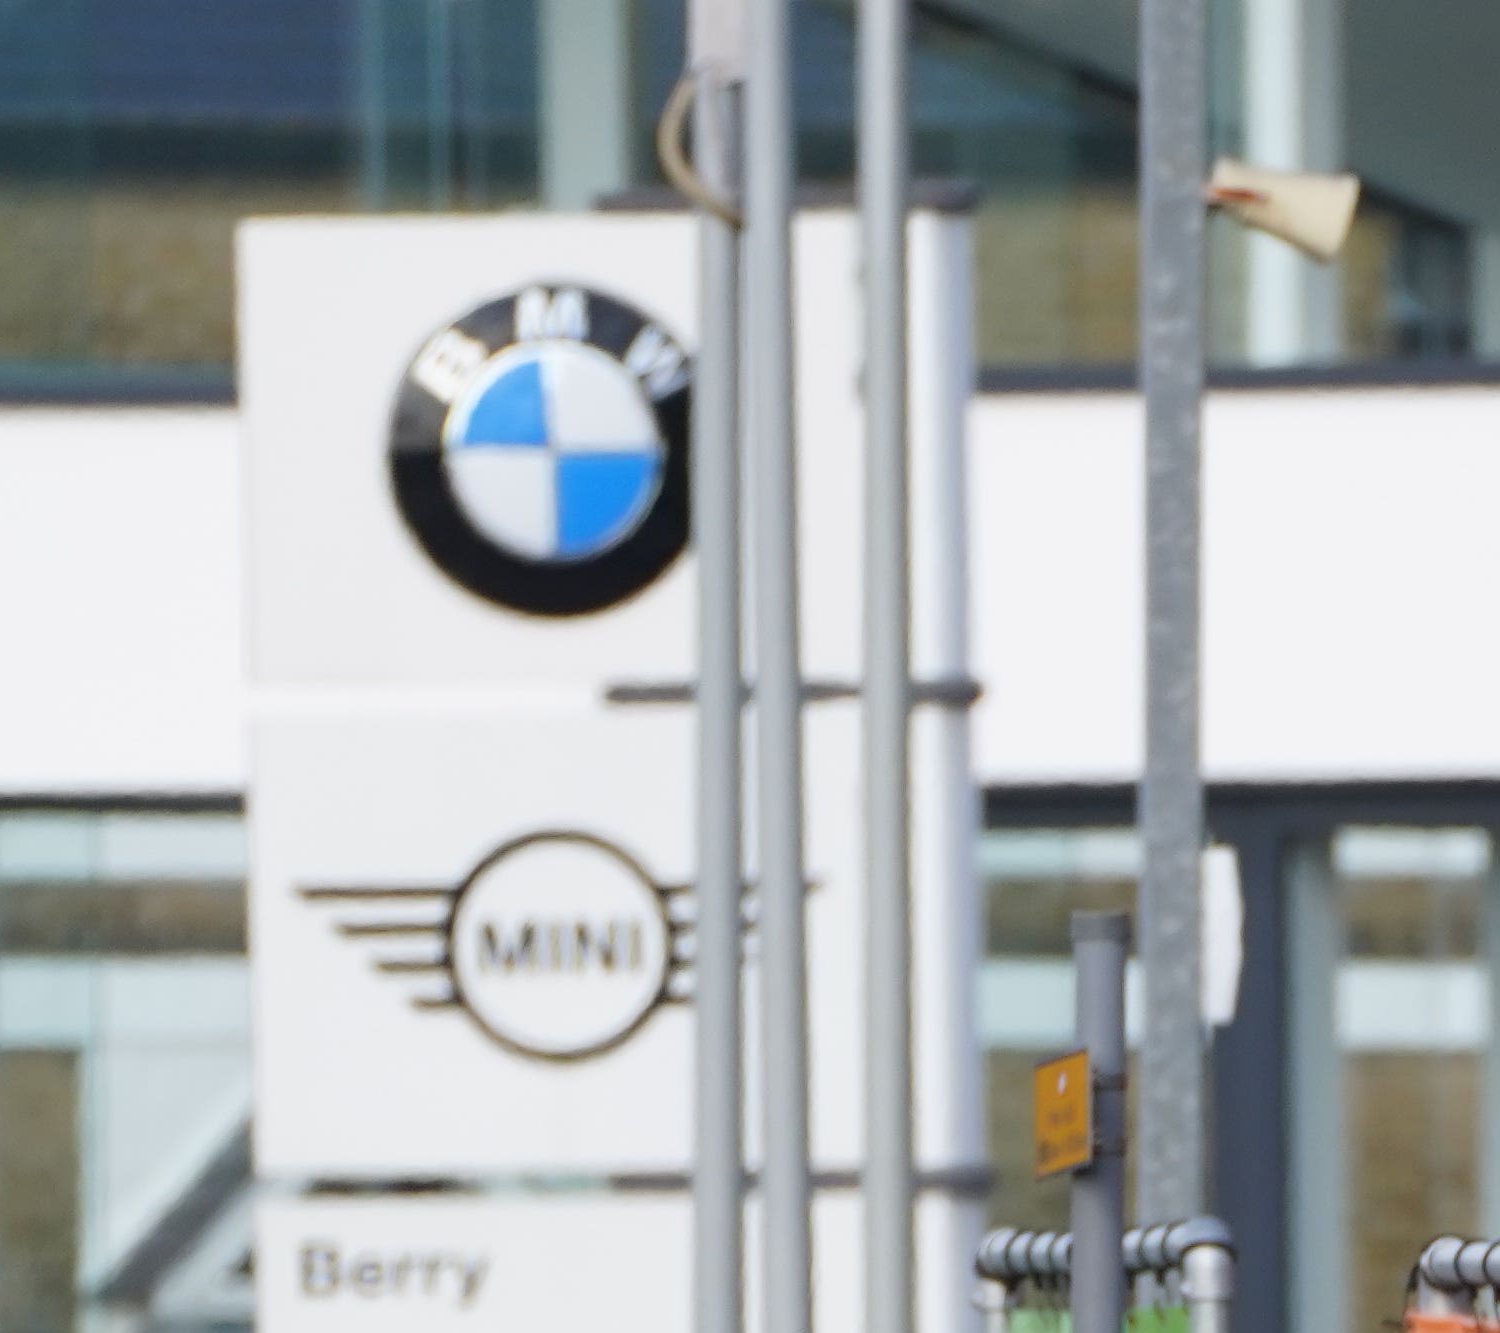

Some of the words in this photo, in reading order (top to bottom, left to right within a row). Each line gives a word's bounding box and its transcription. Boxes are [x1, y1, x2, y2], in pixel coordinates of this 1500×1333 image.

[415, 286, 688, 404] BMW
[476, 916, 645, 976] MINI
[299, 1240, 490, 1304] Berry
